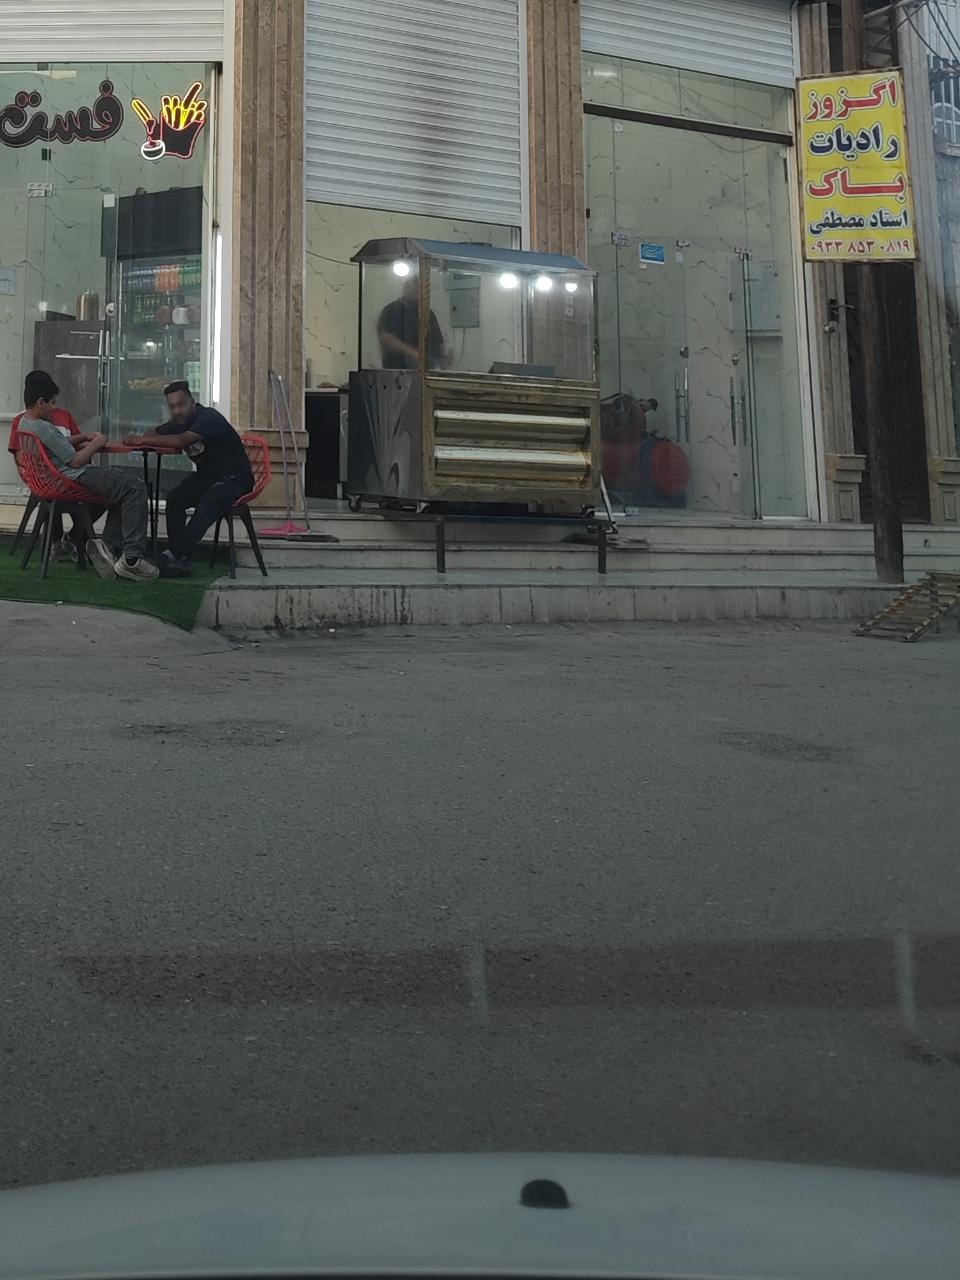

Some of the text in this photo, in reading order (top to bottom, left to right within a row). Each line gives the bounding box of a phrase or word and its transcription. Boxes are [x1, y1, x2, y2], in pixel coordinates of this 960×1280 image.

[805, 78, 897, 121] اگزوز
[809, 124, 899, 160] رادیات
[808, 169, 906, 202] باک
[809, 207, 909, 234] استاد مصطفی
